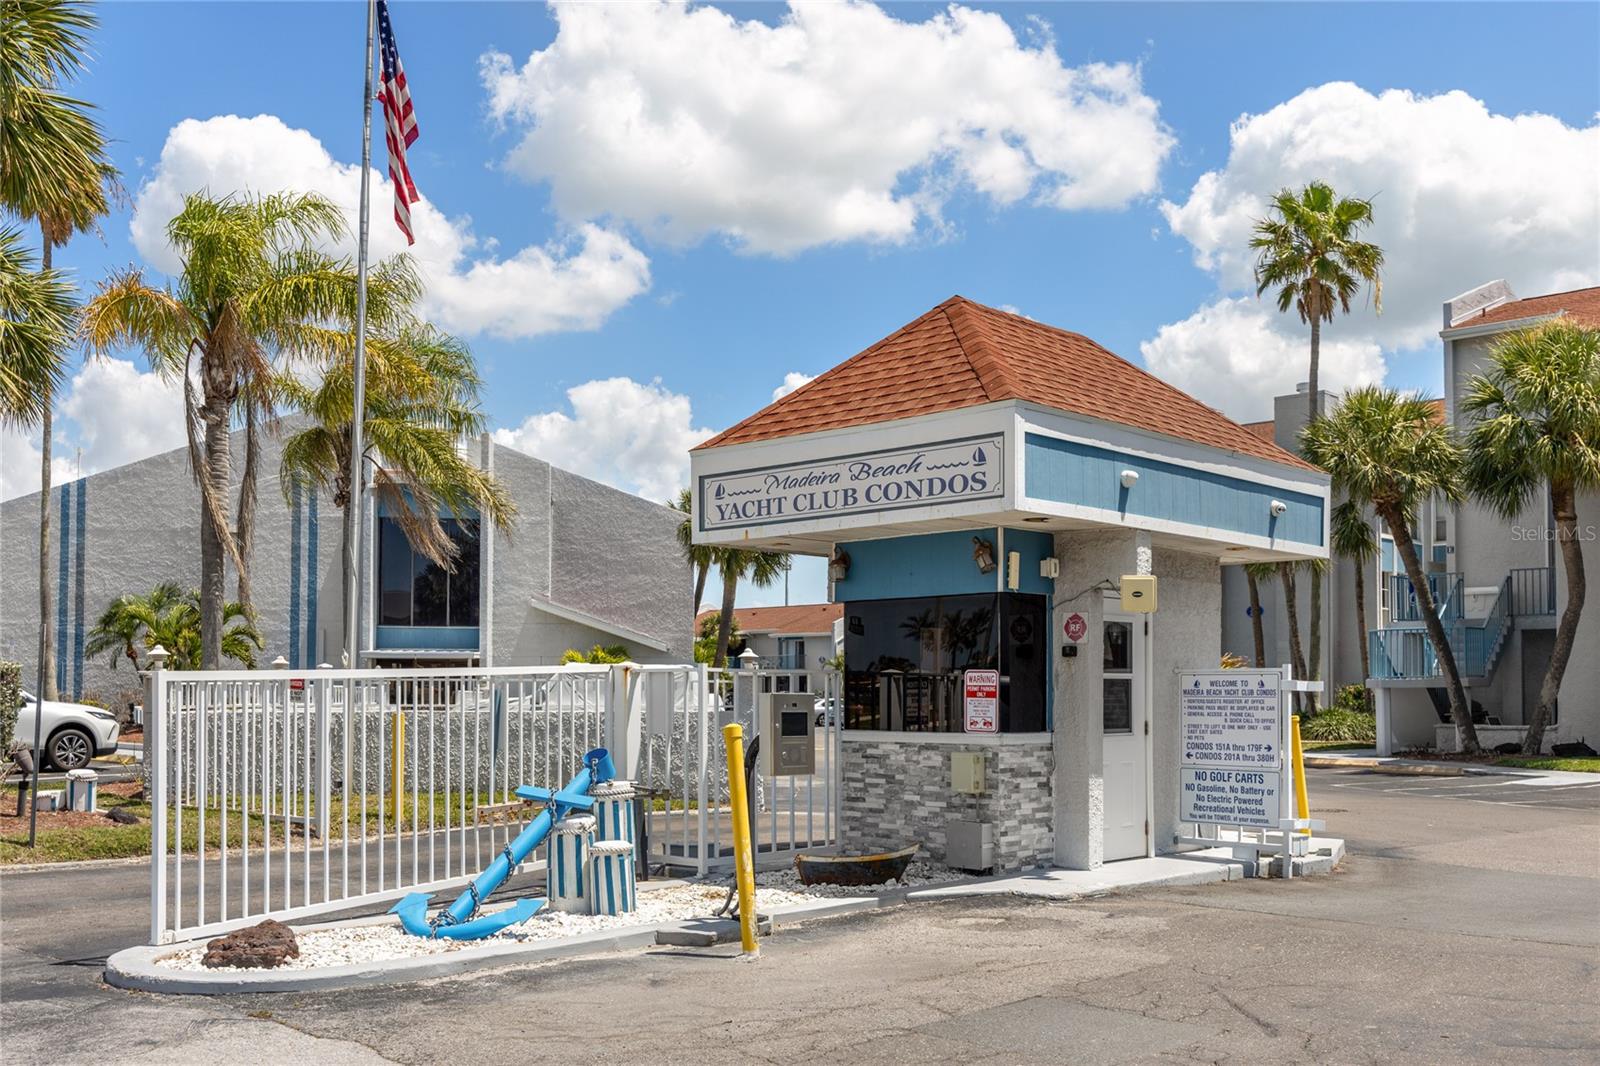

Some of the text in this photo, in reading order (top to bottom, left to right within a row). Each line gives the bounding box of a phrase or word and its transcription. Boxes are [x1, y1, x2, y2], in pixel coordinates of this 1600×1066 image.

[764, 453, 926, 495] Madeira Beach
[715, 470, 988, 521] YACHT CLUB CONDOS
[1070, 623, 1081, 632] RF
[968, 675, 995, 683] WARNING
[1209, 679, 1238, 687] WELCOME
[1183, 688, 1204, 696] MADEIRA
[1206, 688, 1222, 696] BEACH
[1187, 742, 1263, 752] CONDOS 151A thru 179F
[1195, 752, 1274, 762] CONDOS 201A thru 380H
[1195, 771, 1264, 784] NO GOLF CARTS
[1185, 783, 1195, 791] NO
[1229, 785, 1238, 794] No
[1240, 786, 1264, 797] Battery
[1196, 794, 1263, 806] No Electric Powered
[1193, 803, 1265, 816] Recreational Vehicles
